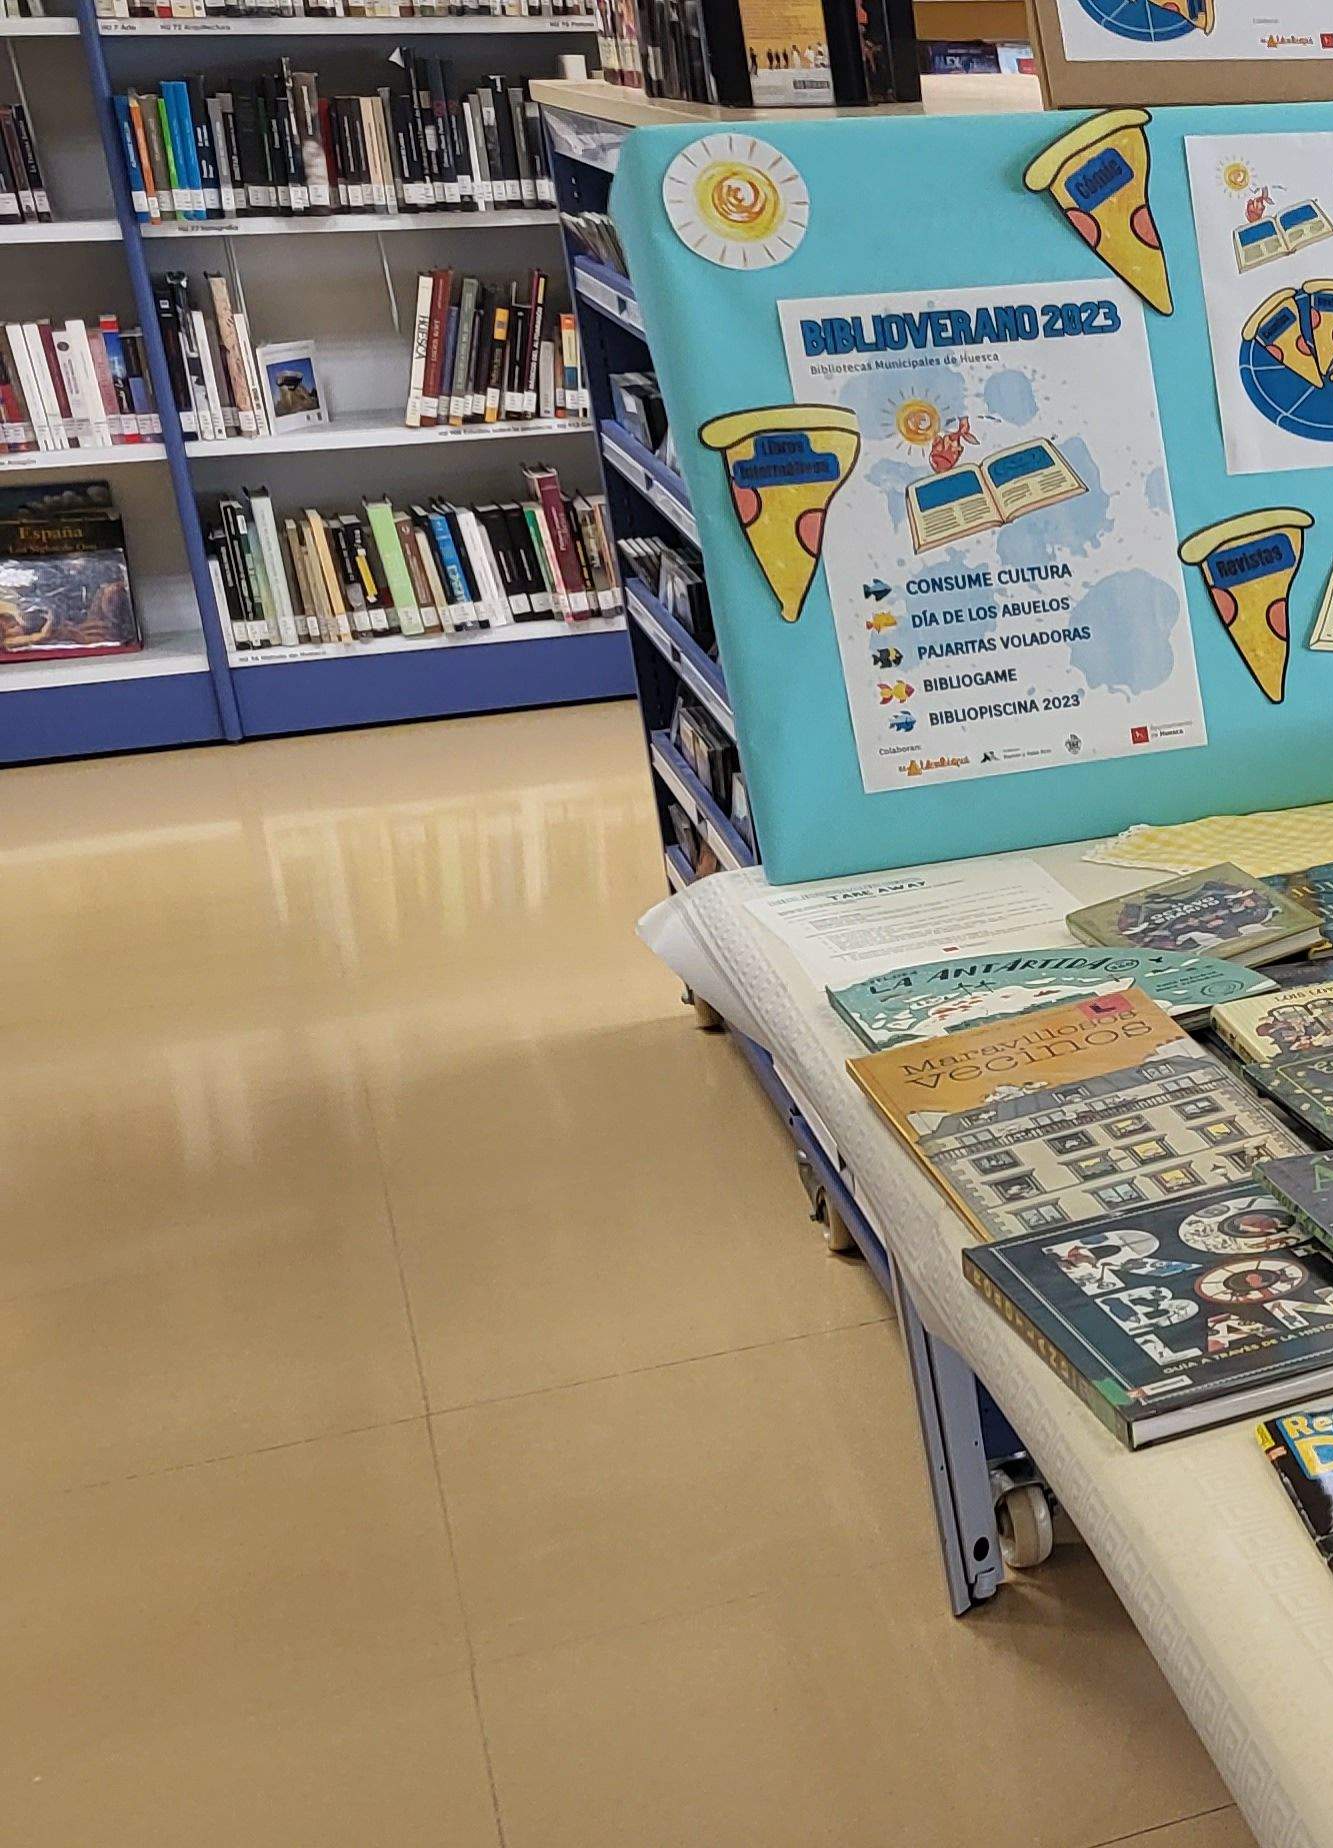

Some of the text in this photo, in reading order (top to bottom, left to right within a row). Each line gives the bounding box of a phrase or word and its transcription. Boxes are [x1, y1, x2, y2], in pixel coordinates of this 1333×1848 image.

[800, 300, 1122, 357] BIBLIOVERANO 2023
[810, 352, 1000, 375] Bibliotecas Municipales de Huesca
[18, 525, 84, 541] España
[905, 563, 1073, 597] CONSUME CULTURA
[911, 596, 1071, 630] DÍA DE LOS ABUELOS
[917, 625, 1092, 661] PAJARITAS VOLADORAS
[922, 668, 1018, 694] BIBLIOGAME
[929, 694, 1081, 728] BIBLIOPISCINA 2023
[1162, 1361, 1198, 1375] GUÍA
[1212, 1345, 1260, 1363] TRAVÉS
[1260, 1338, 1277, 1347] DE
[1278, 1333, 1297, 1343] LA
